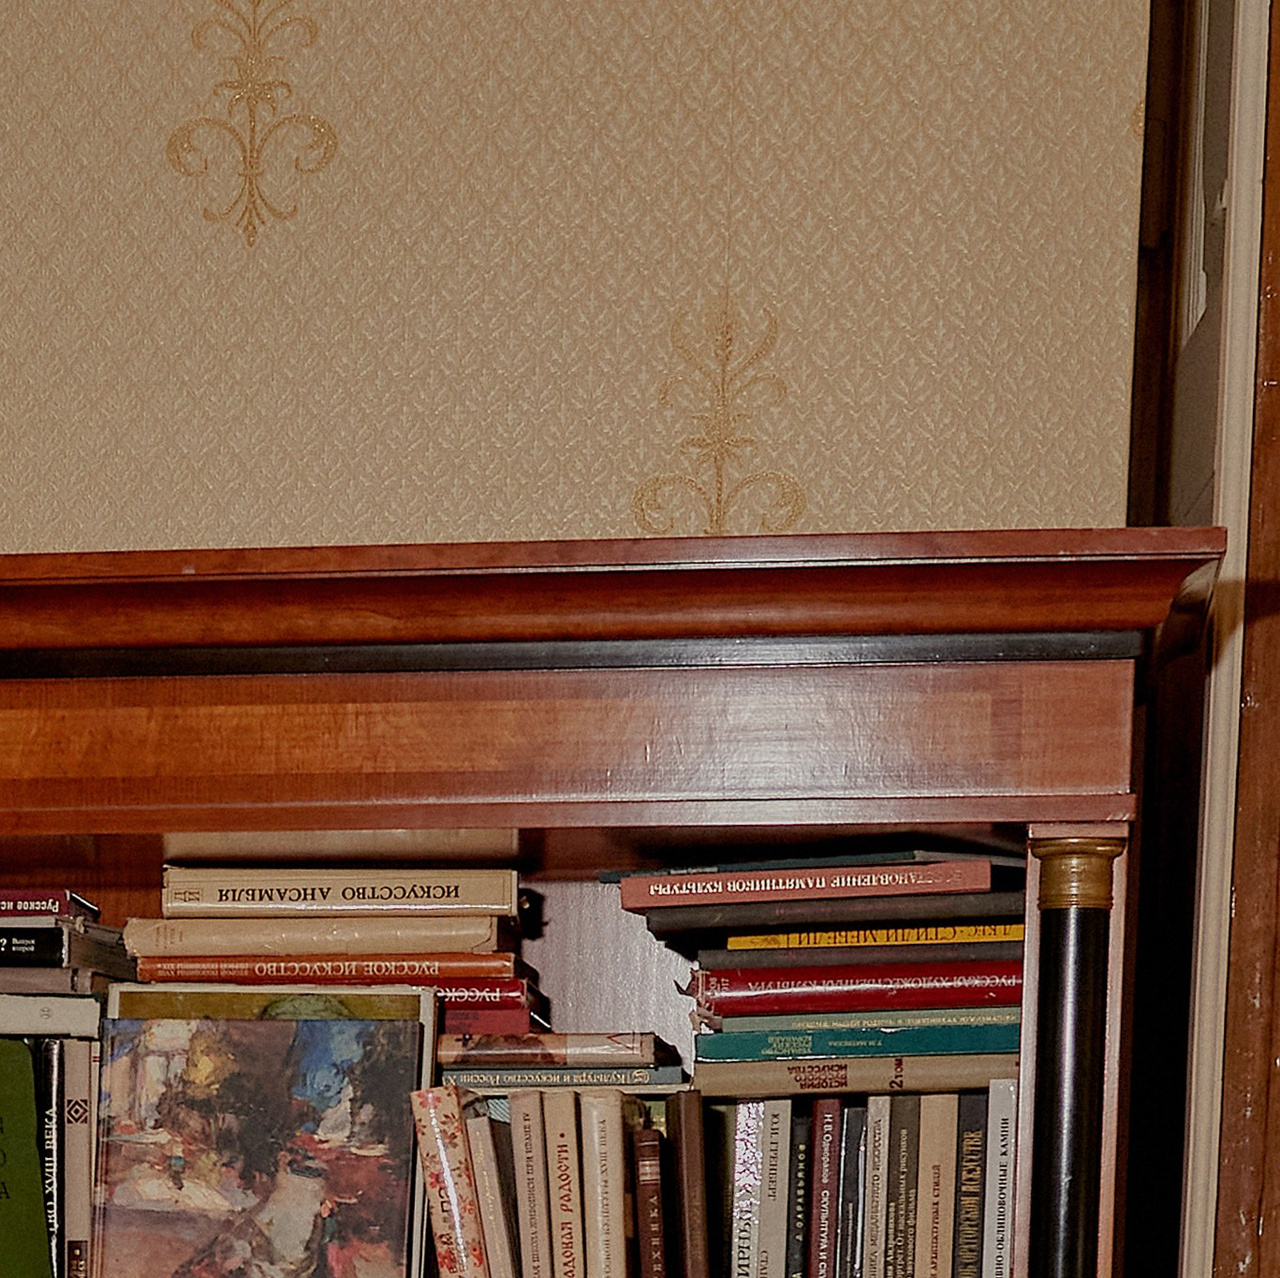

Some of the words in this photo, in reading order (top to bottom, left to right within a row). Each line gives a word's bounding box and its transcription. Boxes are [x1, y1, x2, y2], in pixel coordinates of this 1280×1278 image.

[217, 886, 331, 902] АНСАМБЛЯ
[341, 884, 459, 900] ИСКУССТВО
[254, 962, 359, 977] ИСКУССТВО
[362, 961, 440, 975] РУССКОЕ
[557, 1143, 573, 1213] РАДОСТИ
